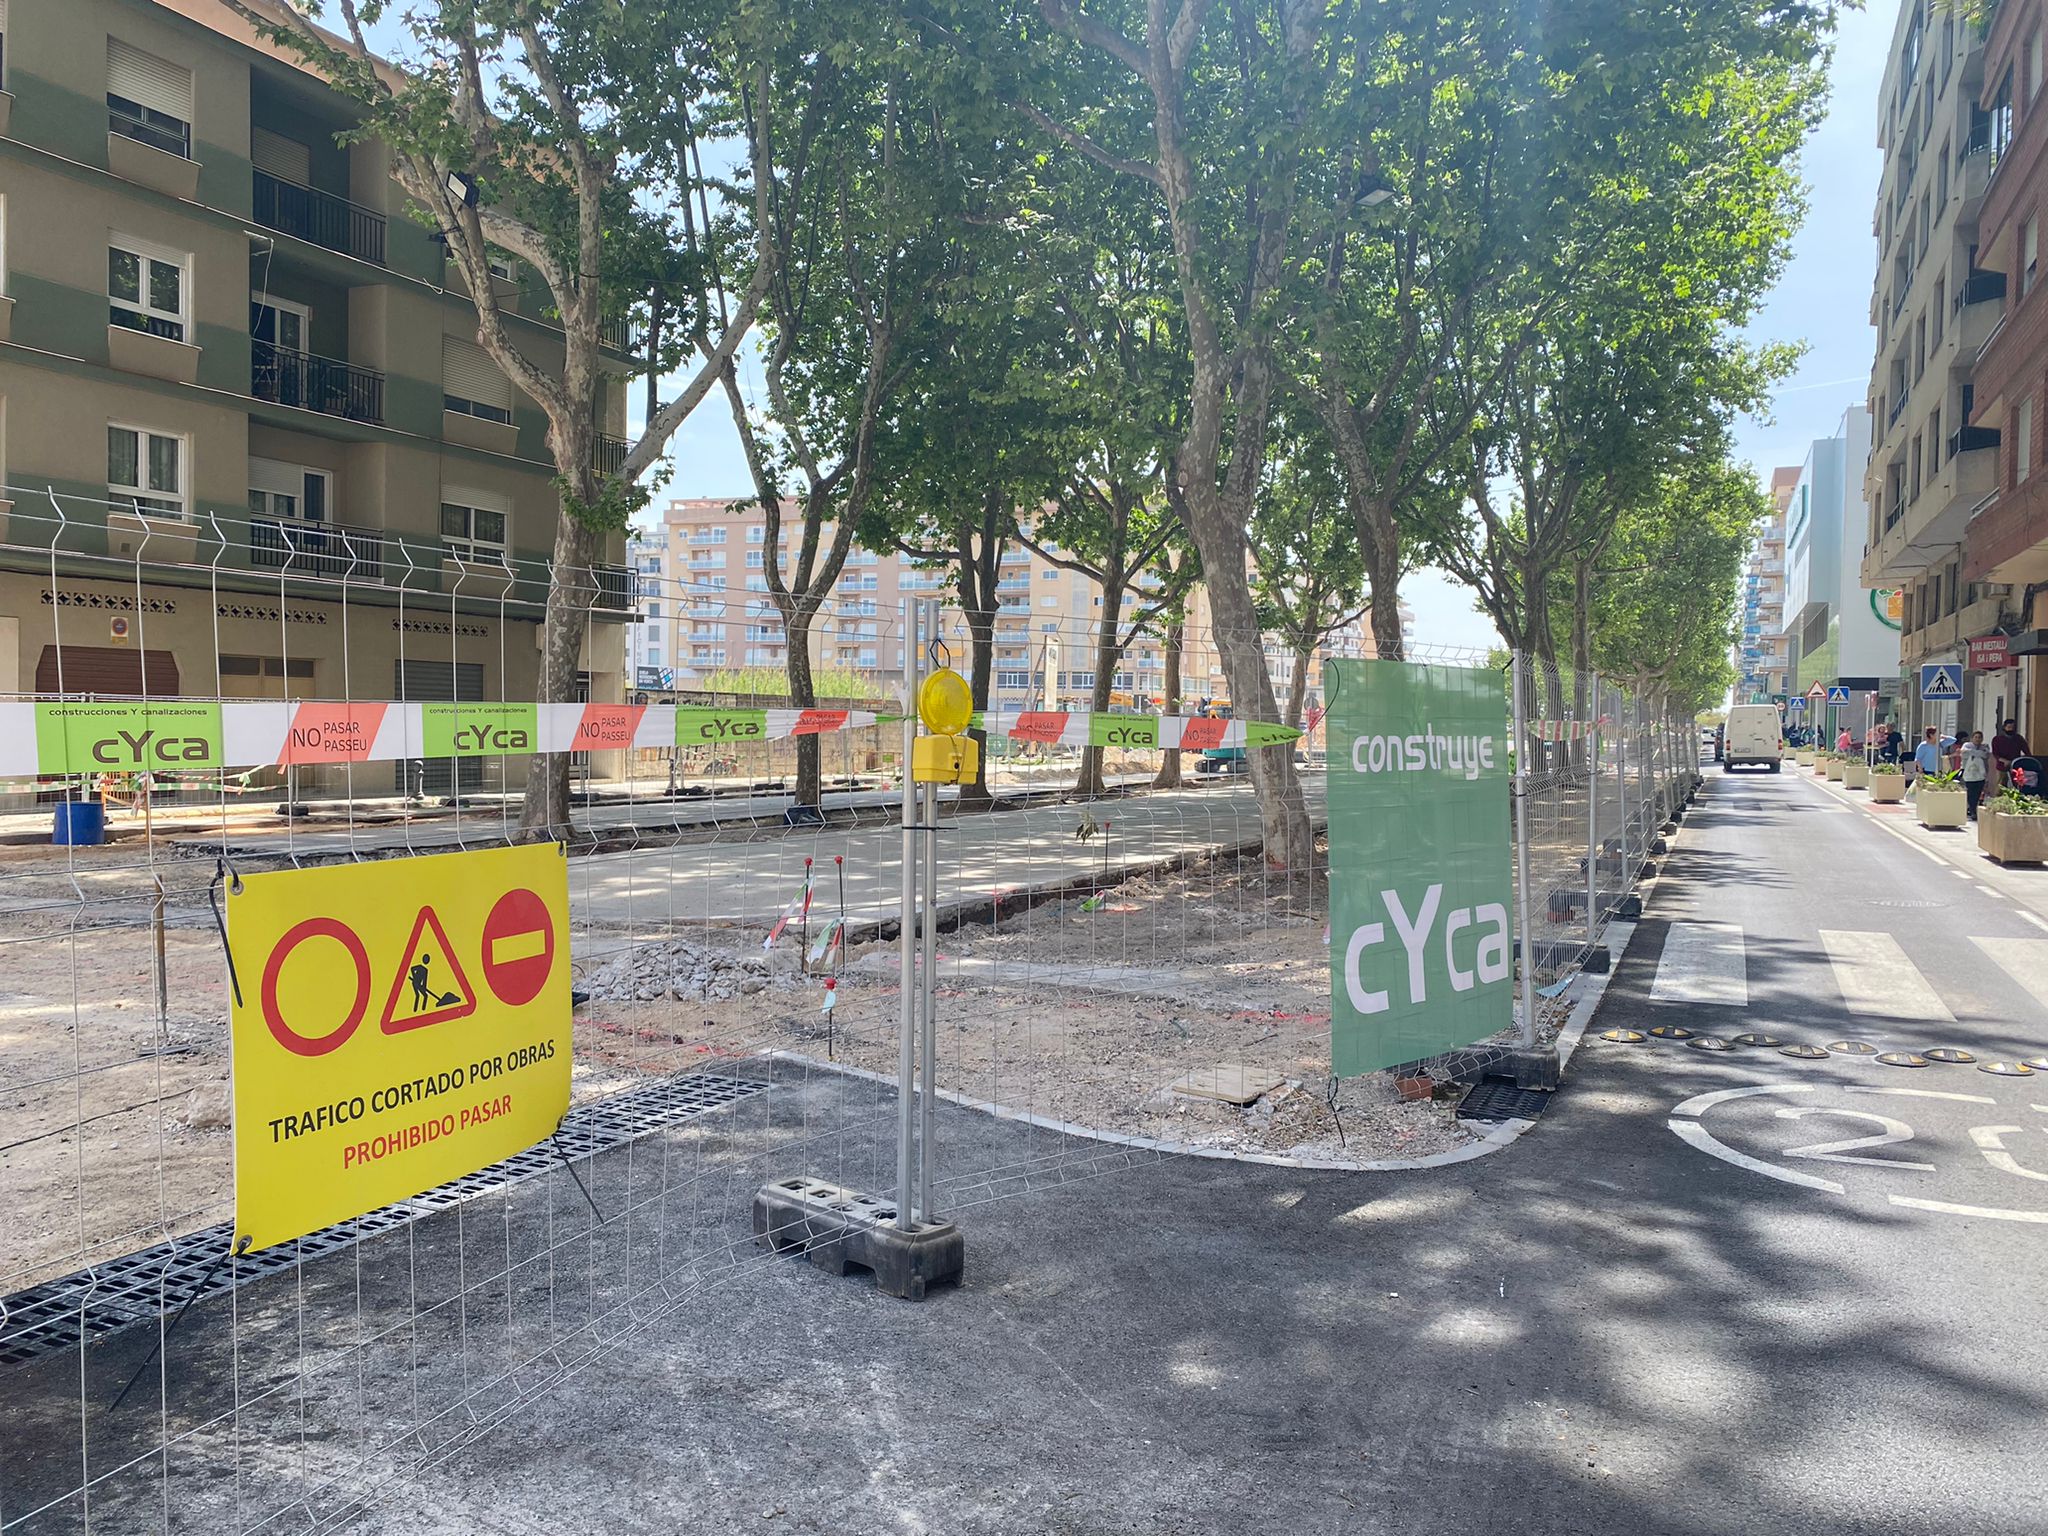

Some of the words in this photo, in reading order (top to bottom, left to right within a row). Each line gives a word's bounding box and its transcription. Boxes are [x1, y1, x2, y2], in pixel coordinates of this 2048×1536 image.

[49, 708, 128, 717] construcciones
[130, 708, 138, 716] Y
[141, 708, 208, 716] canalizaciones
[601, 717, 626, 727] PASAR
[324, 721, 361, 734] PASAR
[453, 724, 528, 750] cYca
[580, 721, 600, 738] NO
[601, 731, 631, 741] PASSEU
[701, 719, 760, 738] cYca
[1107, 727, 1153, 744] cYca
[92, 730, 210, 763] cYca
[292, 727, 321, 748] NO
[324, 738, 367, 752] PASSEU
[1352, 722, 1495, 781] construye
[1344, 883, 1509, 1015] cYca
[268, 1096, 365, 1143] TRAFICO
[371, 1068, 465, 1113] CORTADO
[469, 1056, 503, 1085] POR
[507, 1039, 556, 1072] OBRAS
[343, 1114, 455, 1169] PROHIBIDO
[460, 1094, 512, 1131] PASAR
